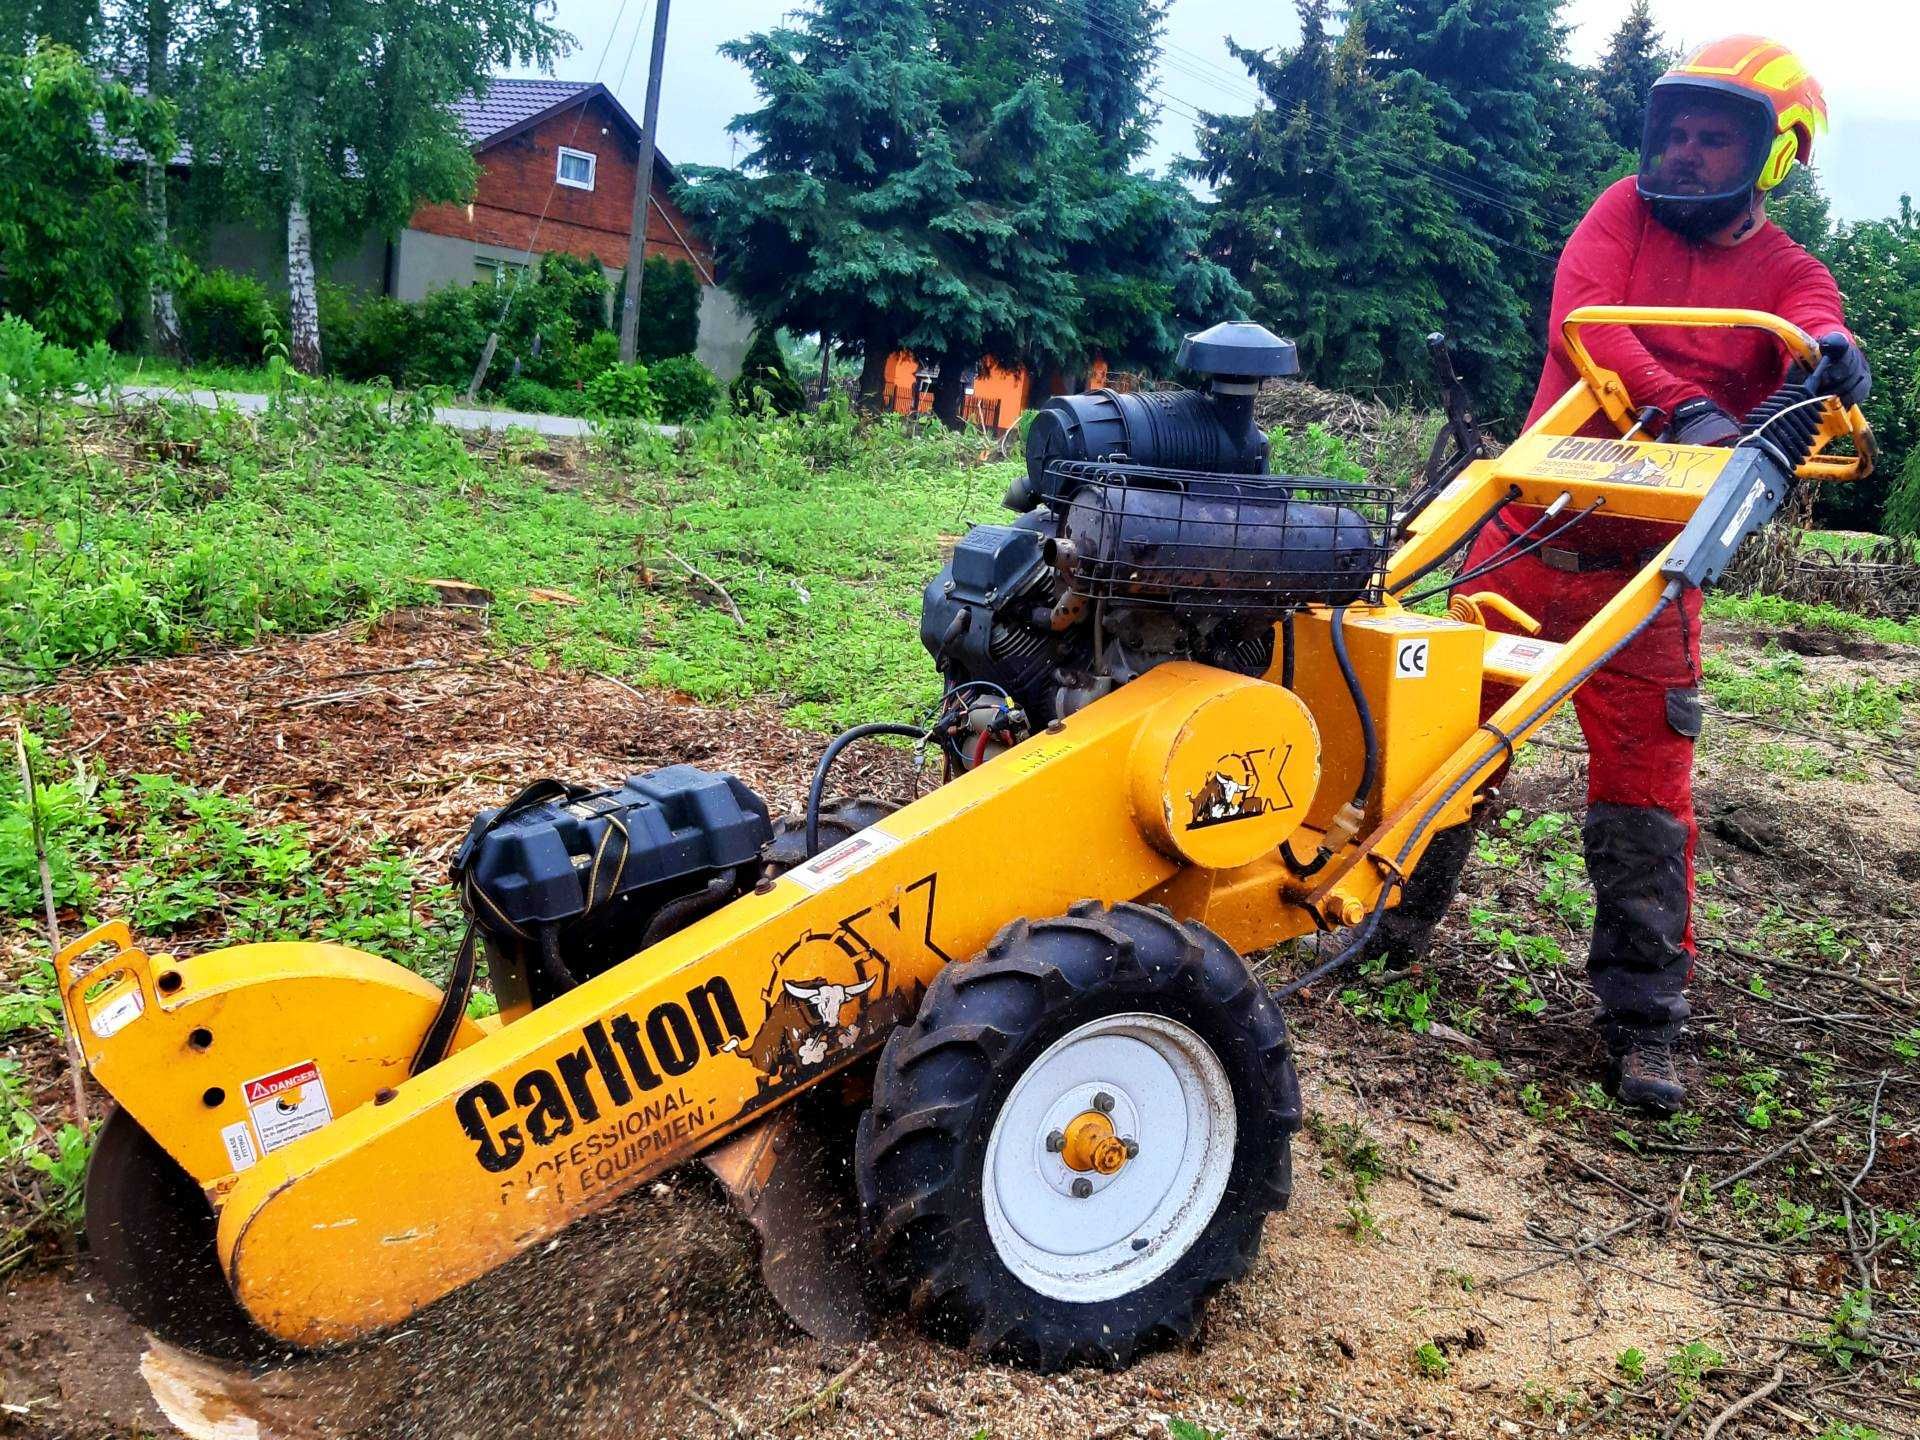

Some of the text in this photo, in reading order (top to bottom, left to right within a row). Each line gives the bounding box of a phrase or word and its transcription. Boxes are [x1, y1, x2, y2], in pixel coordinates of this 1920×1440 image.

[1546, 436, 1640, 464] Carlton
[1399, 644, 1426, 672] CE
[268, 1070, 316, 1094] DANGER
[455, 975, 750, 1173] Carlton
